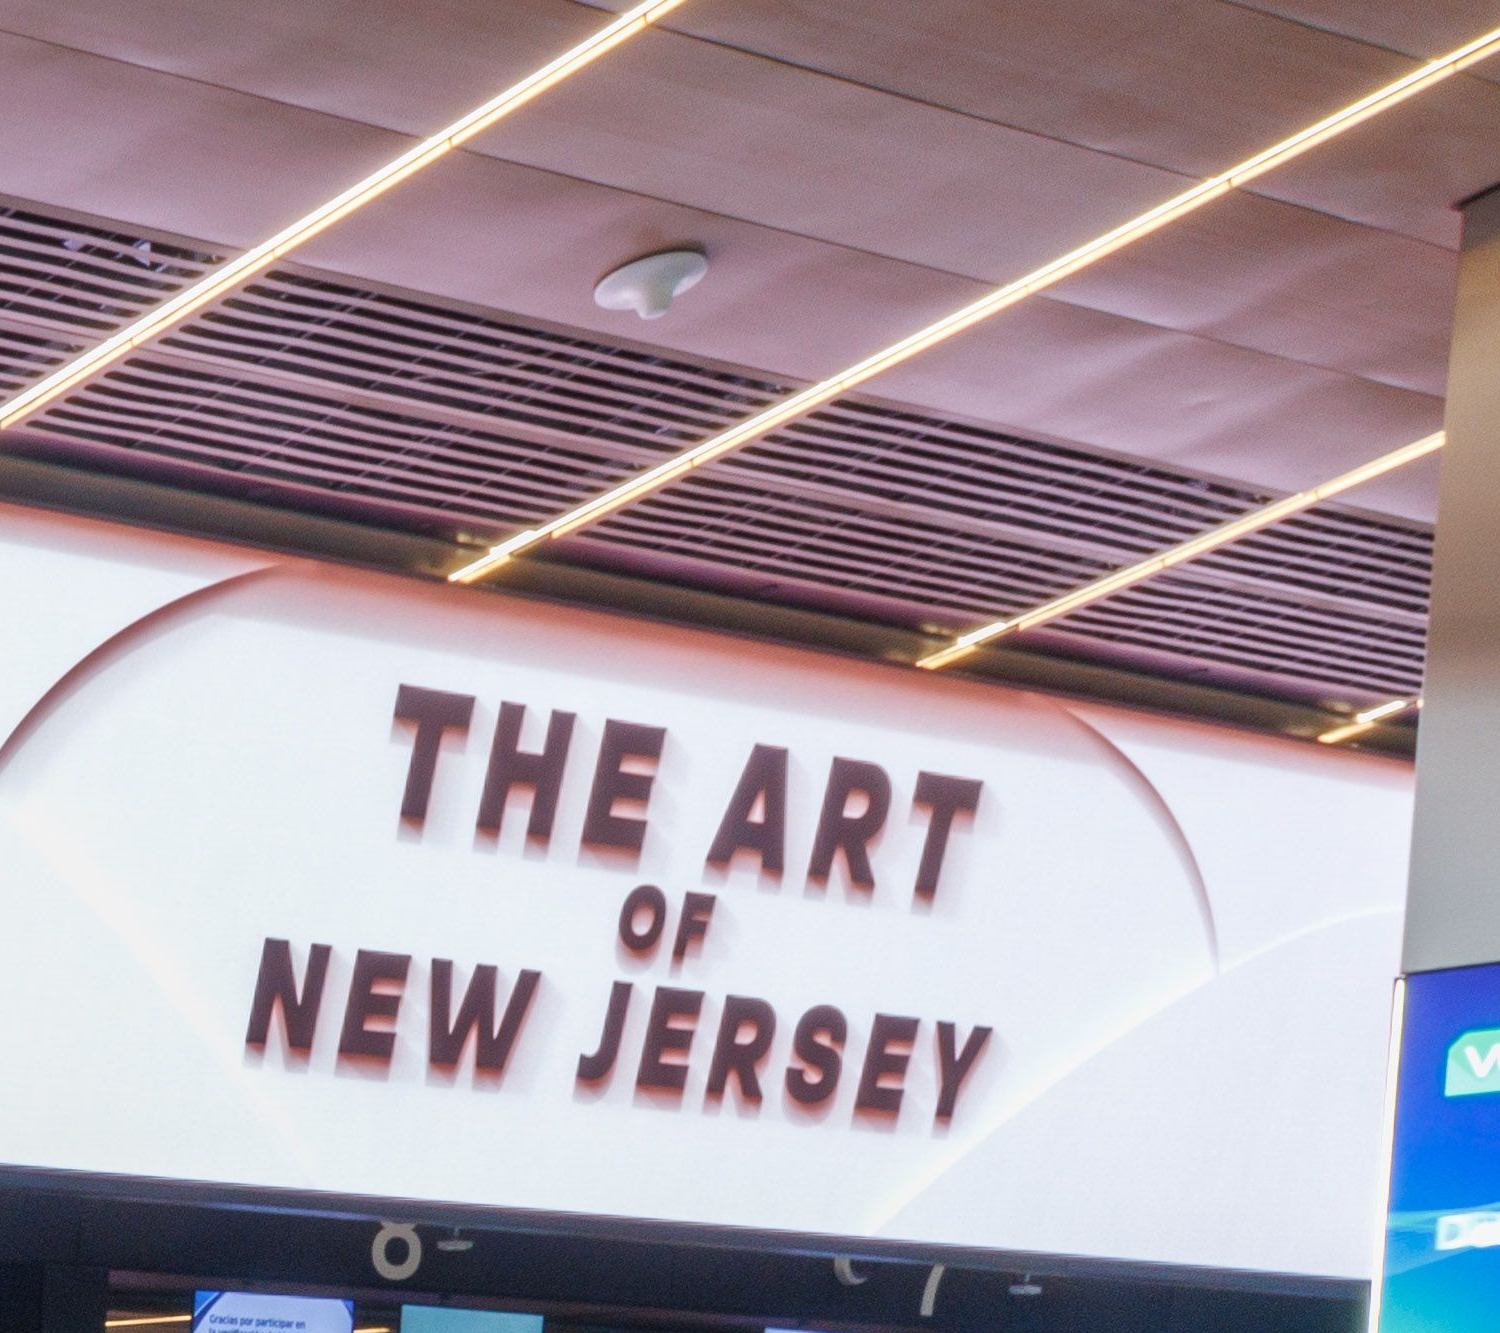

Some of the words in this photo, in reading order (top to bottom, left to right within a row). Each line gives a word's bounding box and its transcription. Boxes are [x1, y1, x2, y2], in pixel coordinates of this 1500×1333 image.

[394, 682, 668, 853] THE
[706, 741, 984, 899] ART
[617, 884, 717, 962] OF
[245, 936, 542, 1073] NEW
[575, 980, 994, 1122] JERSEY
